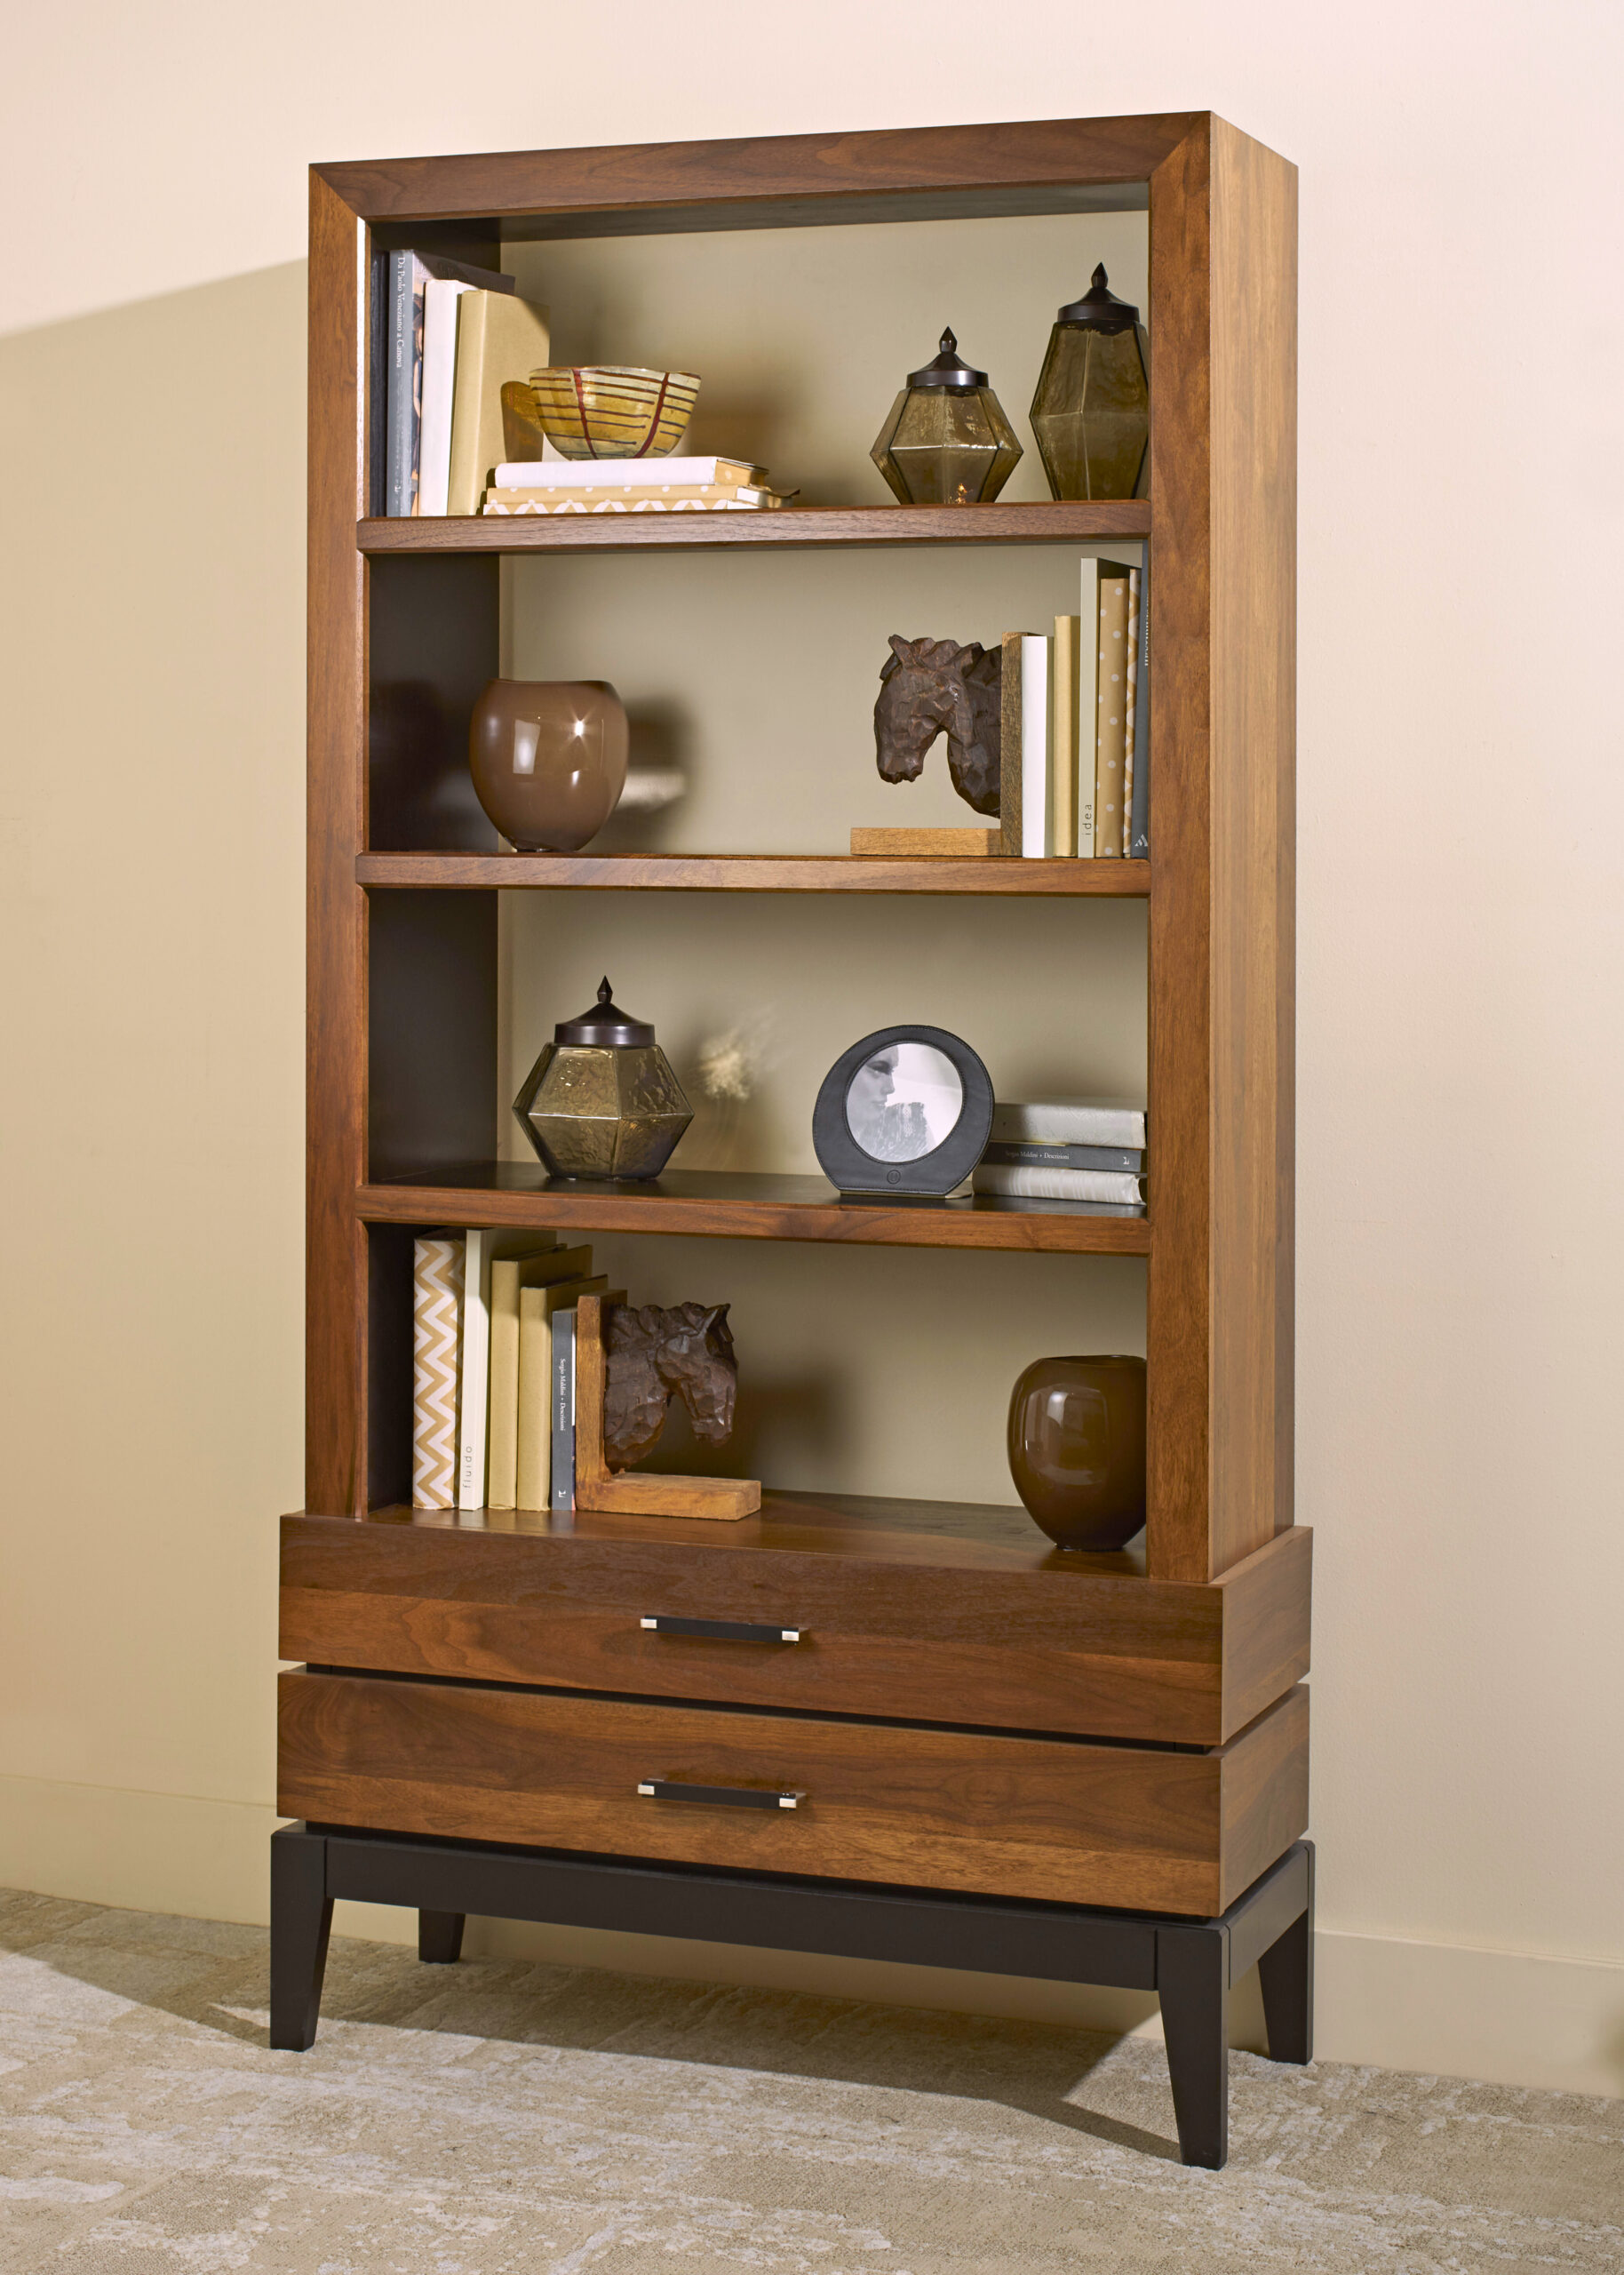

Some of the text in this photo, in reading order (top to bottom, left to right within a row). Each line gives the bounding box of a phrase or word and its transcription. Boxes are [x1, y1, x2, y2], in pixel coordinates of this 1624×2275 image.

[397, 257, 406, 268] Da
[397, 270, 406, 291] Paolo
[396, 293, 406, 331] Veneziano
[396, 339, 405, 368] Canova
[1082, 804, 1092, 835] idea
[462, 1446, 473, 1489] fluido
